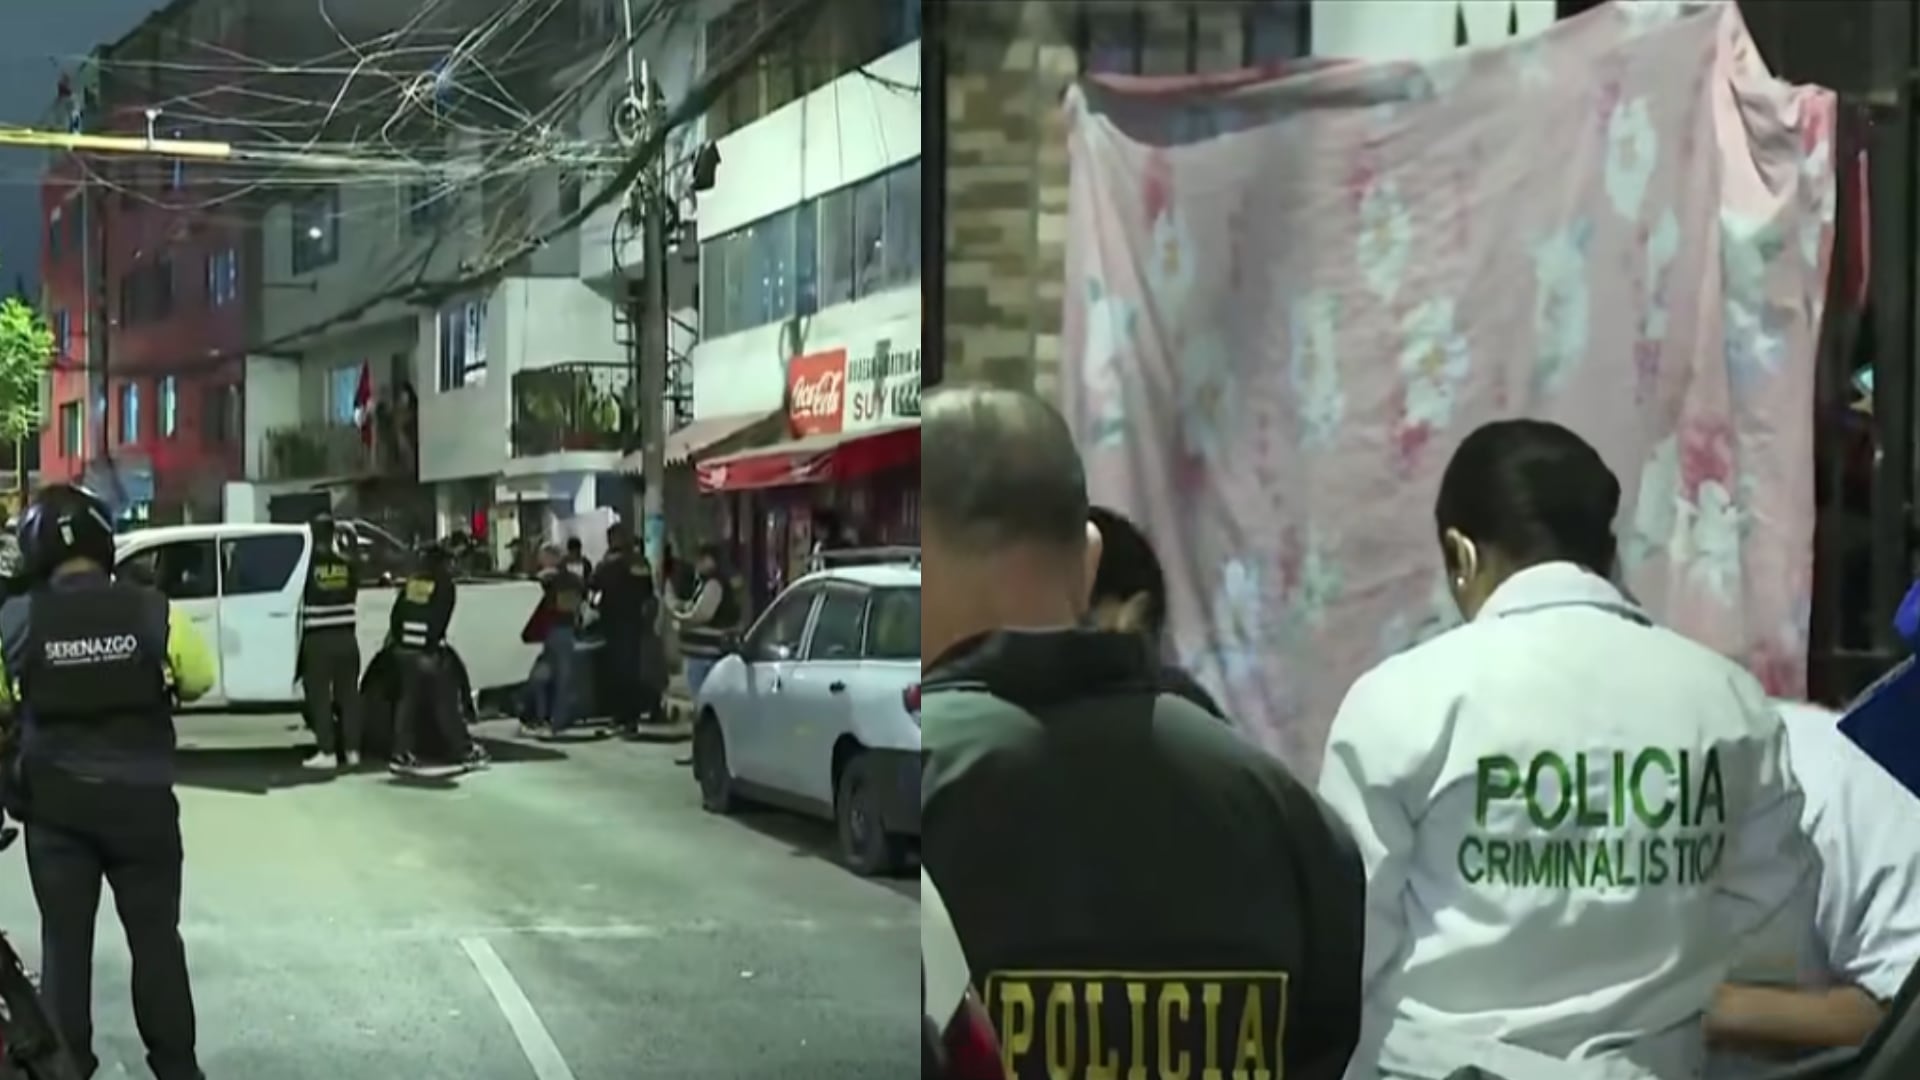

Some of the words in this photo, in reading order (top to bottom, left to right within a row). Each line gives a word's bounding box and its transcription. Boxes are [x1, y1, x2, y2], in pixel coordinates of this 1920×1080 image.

[45, 635, 137, 659] SERENAZGO
[1475, 746, 1725, 830] POLICIA
[1000, 982, 1270, 1080] POLICIA
